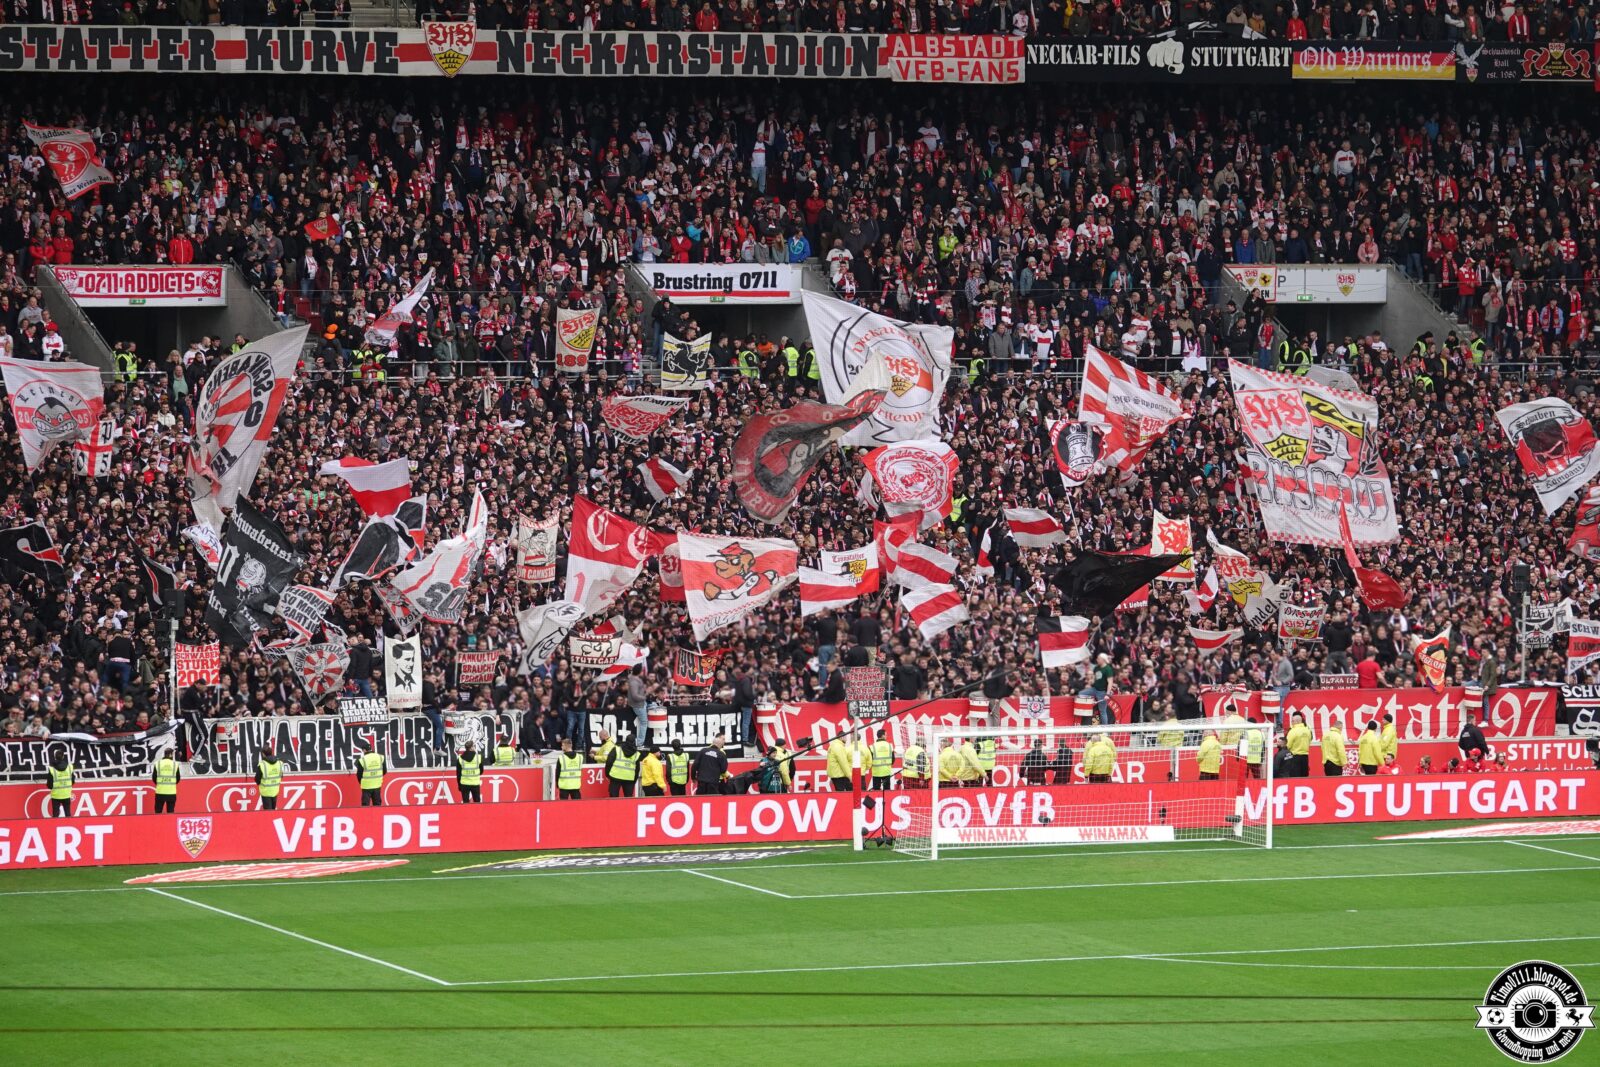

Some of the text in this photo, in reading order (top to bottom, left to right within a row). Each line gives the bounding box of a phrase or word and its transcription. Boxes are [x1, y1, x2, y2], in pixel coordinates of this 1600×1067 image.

[245, 28, 399, 74] KURVE
[497, 31, 880, 76] NECKARSTADION
[893, 35, 1021, 58] ALBSTADT
[1026, 43, 1141, 66] NECKAR-FILS
[1191, 45, 1292, 67] STUTTGART
[1299, 46, 1336, 72] Old
[1341, 46, 1432, 72] Warriors
[900, 59, 1020, 83] VFB-FANS
[653, 271, 778, 293] Brustring 0711
[556, 353, 588, 367] 189
[175, 643, 220, 653] ULTRAS
[176, 652, 220, 660] SCHWABEN
[177, 659, 220, 671] STURM
[178, 669, 220, 687] 2002
[340, 697, 387, 710] ULTRAS
[1491, 691, 1549, 738] 97
[587, 769, 605, 785] 34
[1243, 777, 1586, 821] VfB STUTTGART
[636, 797, 838, 838] FOLLOW
[937, 790, 1056, 829] @VfB
[272, 812, 441, 853] VfB.DE
[958, 828, 1029, 842] WINAMAX
[1078, 826, 1149, 841] WINAMAX
